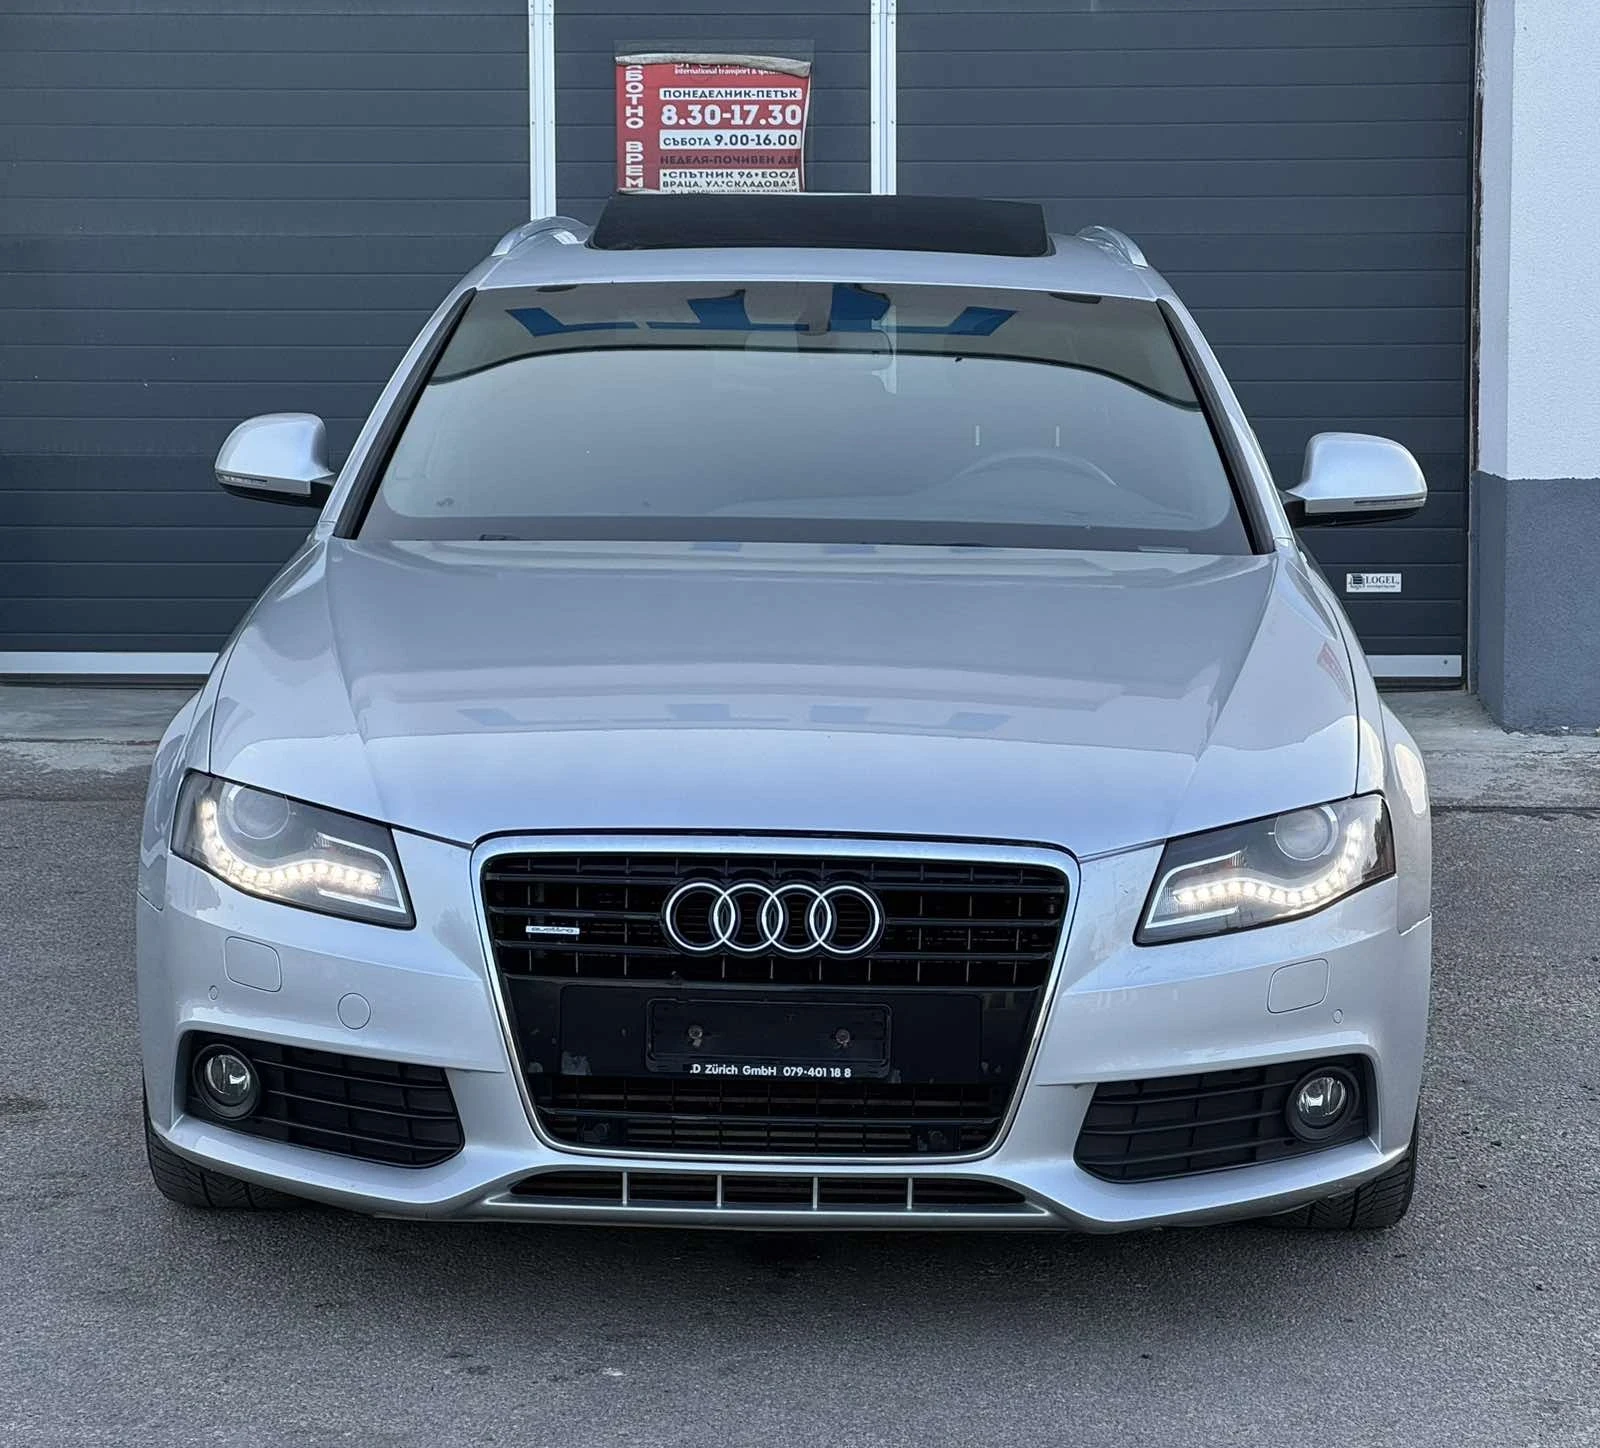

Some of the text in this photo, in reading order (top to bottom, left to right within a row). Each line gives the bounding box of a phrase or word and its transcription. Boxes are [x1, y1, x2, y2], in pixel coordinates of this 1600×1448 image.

[663, 90, 797, 99] ПОНЕДЕЛНИК-ПЕТЪК
[661, 104, 802, 126] 8.30-17.30
[663, 134, 798, 146] СЪБОТА 9.00-16.00
[660, 155, 775, 165] НЕДЕЛЯ-ПОЧИВЕН
[704, 1064, 738, 1075] Zürich
[742, 1065, 777, 1076] GmbH
[830, 1067, 841, 1078] 18
[844, 1067, 852, 1078] 8
